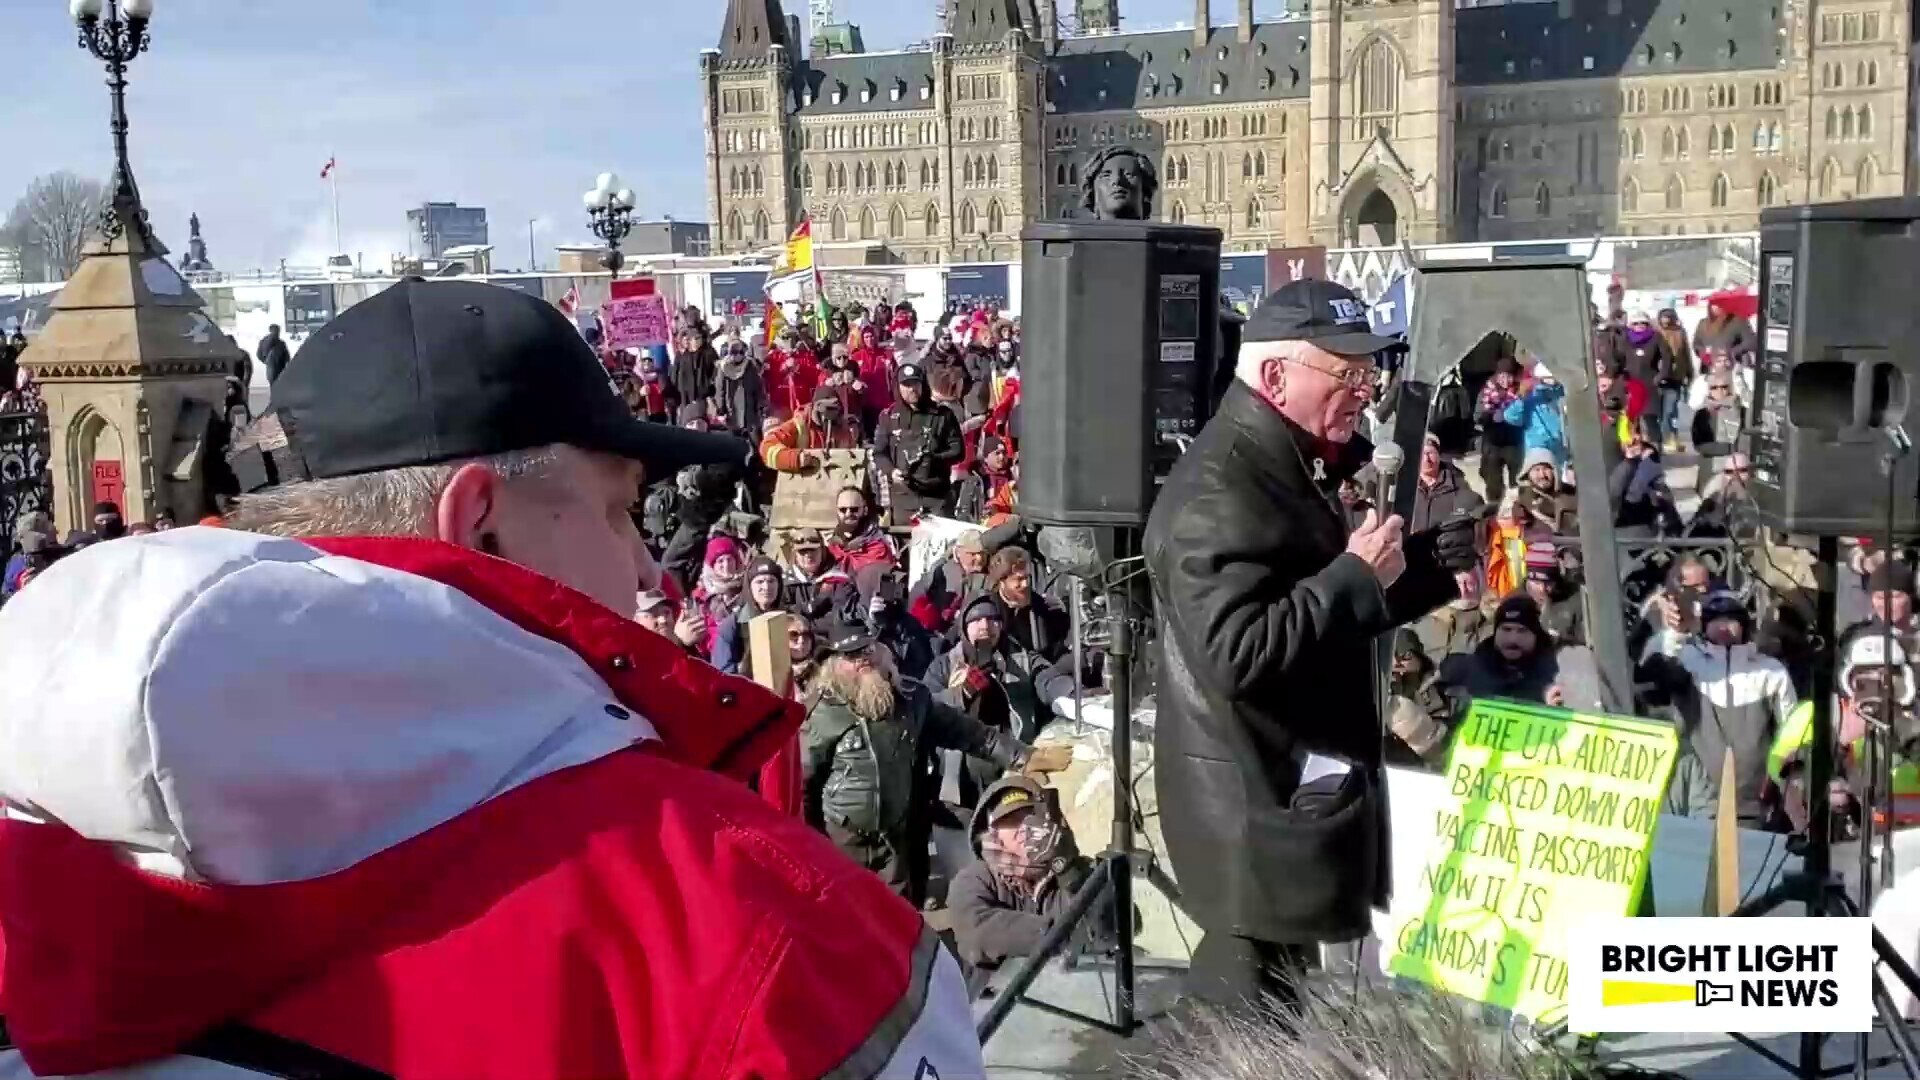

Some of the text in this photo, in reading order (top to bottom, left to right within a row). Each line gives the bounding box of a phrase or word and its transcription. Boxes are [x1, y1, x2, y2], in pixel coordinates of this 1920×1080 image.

[1468, 713, 1519, 751] THE
[1573, 733, 1667, 784] ALREADY
[1451, 763, 1658, 835] BACKED DOWN ON
[1435, 810, 1644, 886] VACCINE PASSPORTS
[1418, 861, 1547, 922] NOW IT IS
[1398, 918, 1517, 985] CANADA'S
